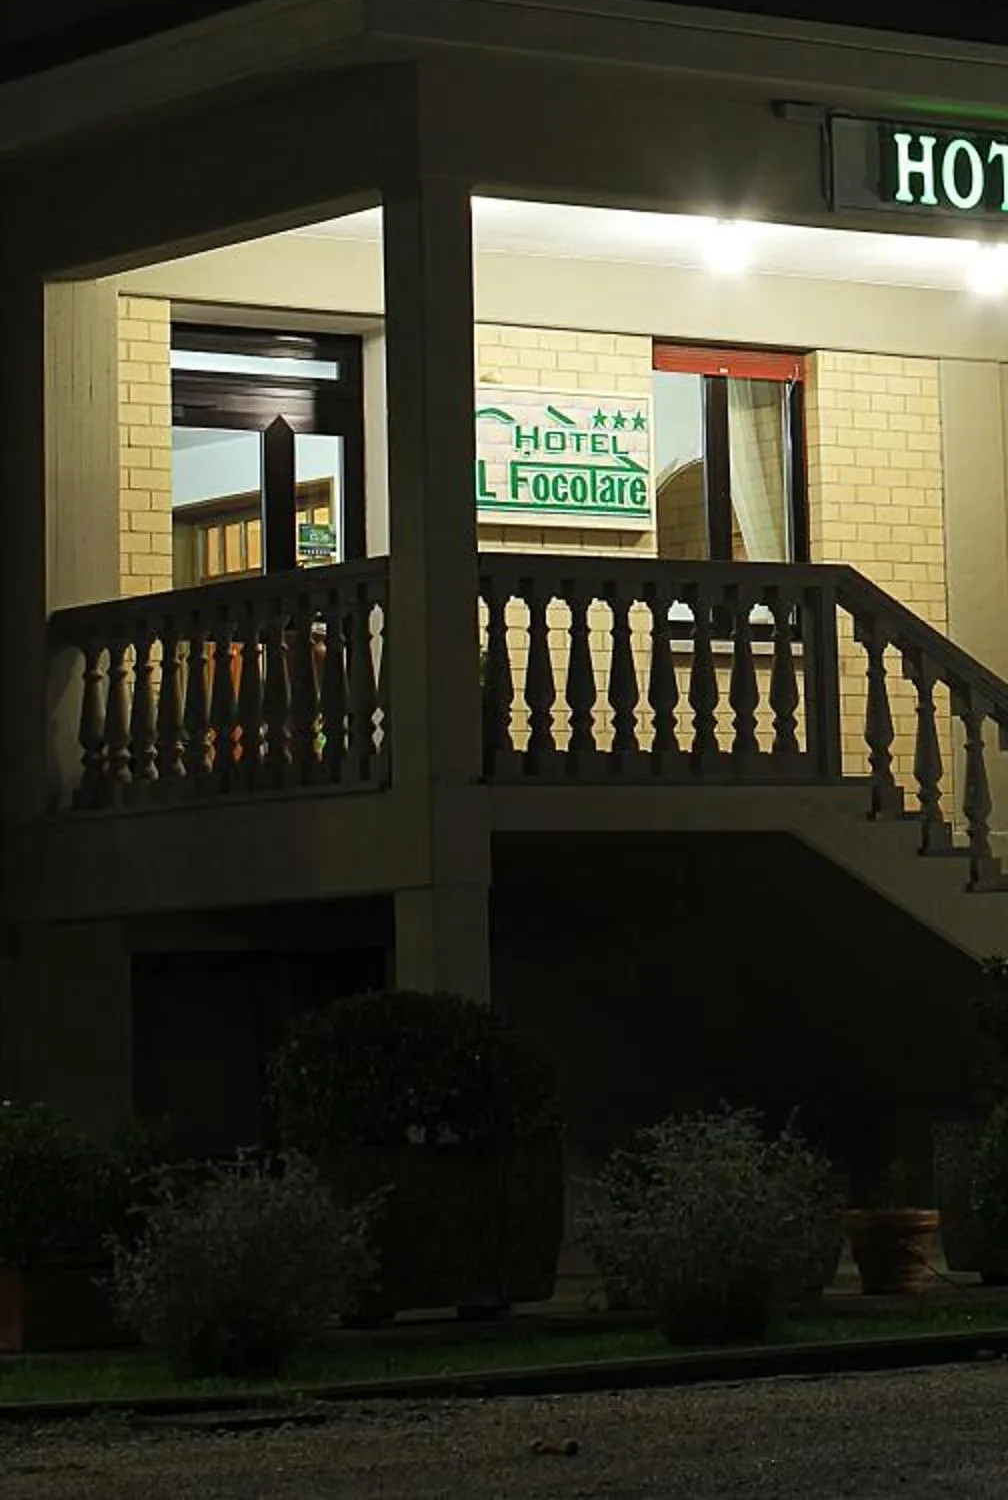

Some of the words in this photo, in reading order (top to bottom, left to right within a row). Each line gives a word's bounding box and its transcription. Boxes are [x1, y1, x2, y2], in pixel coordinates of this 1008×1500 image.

[515, 425, 629, 455] HOTEL
[477, 459, 497, 498] L
[510, 461, 647, 505] Focolare
